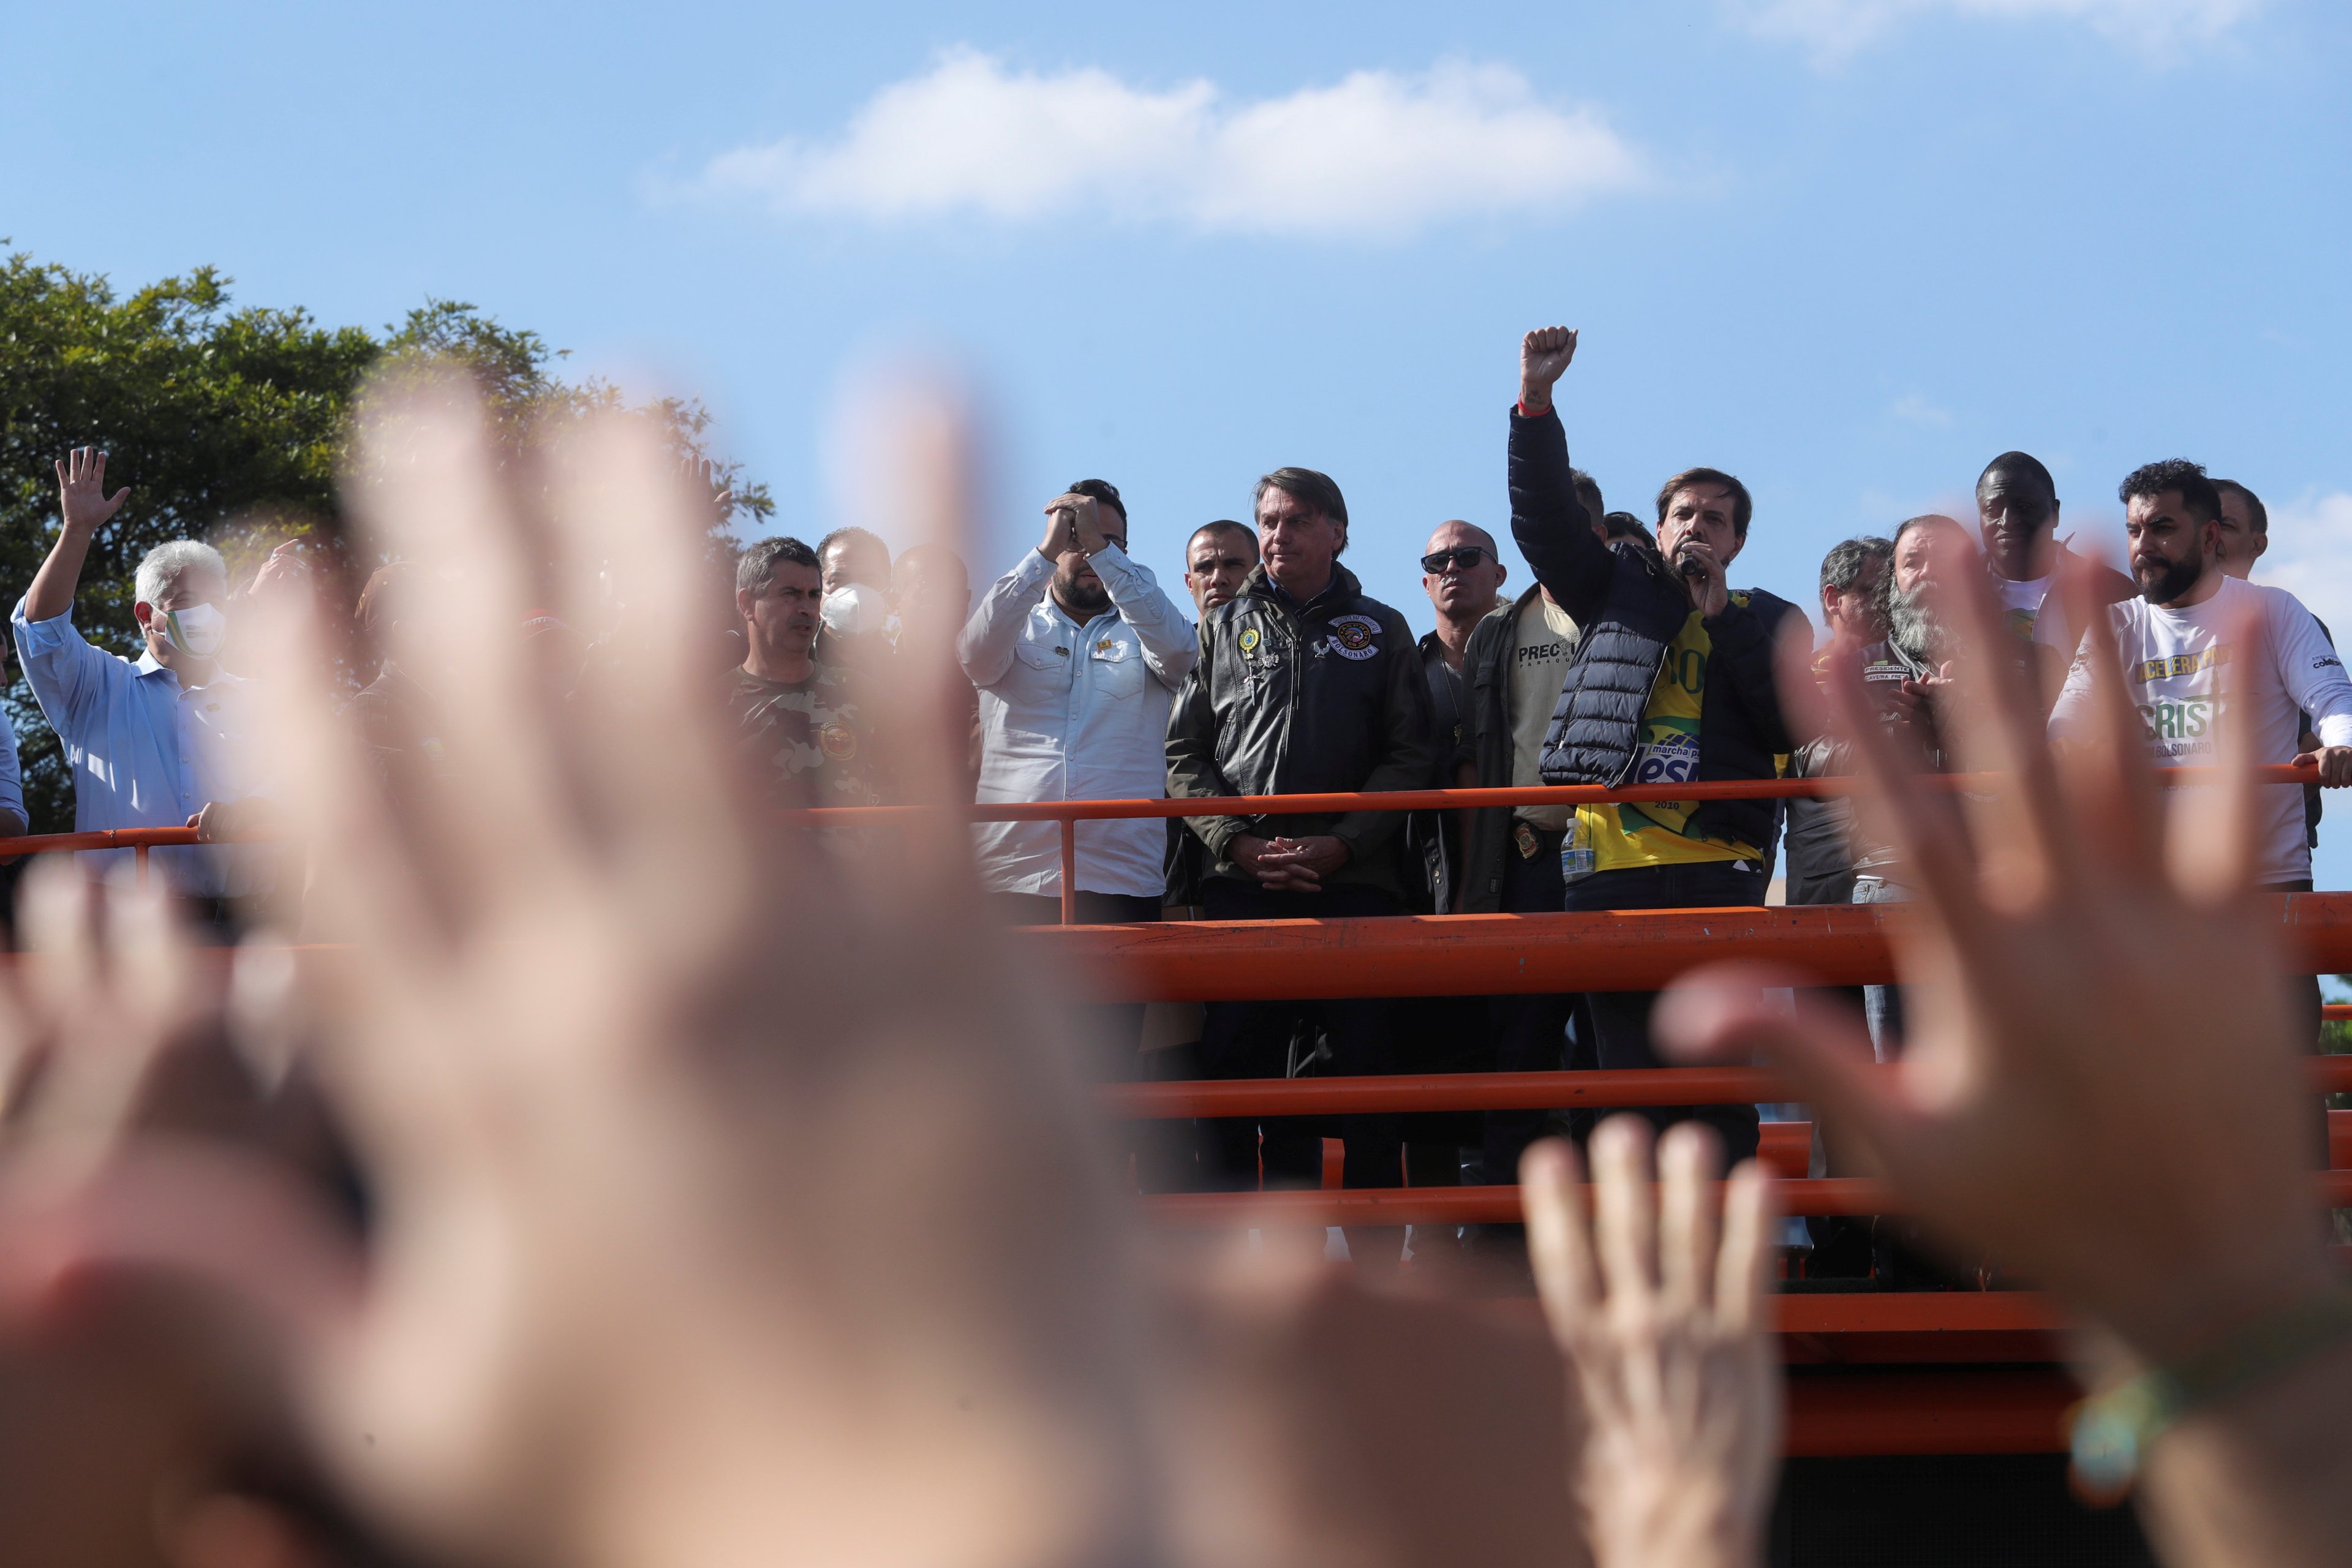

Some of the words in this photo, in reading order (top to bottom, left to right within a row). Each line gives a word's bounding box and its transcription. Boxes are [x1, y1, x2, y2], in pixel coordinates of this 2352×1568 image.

[1332, 639, 1373, 658] BOLSONARO
[2139, 655, 2201, 682] ACELERA
[1653, 745, 1688, 756] marcha
[2156, 742, 2211, 758] BOLSONARO
[1655, 801, 1679, 810] 2010
